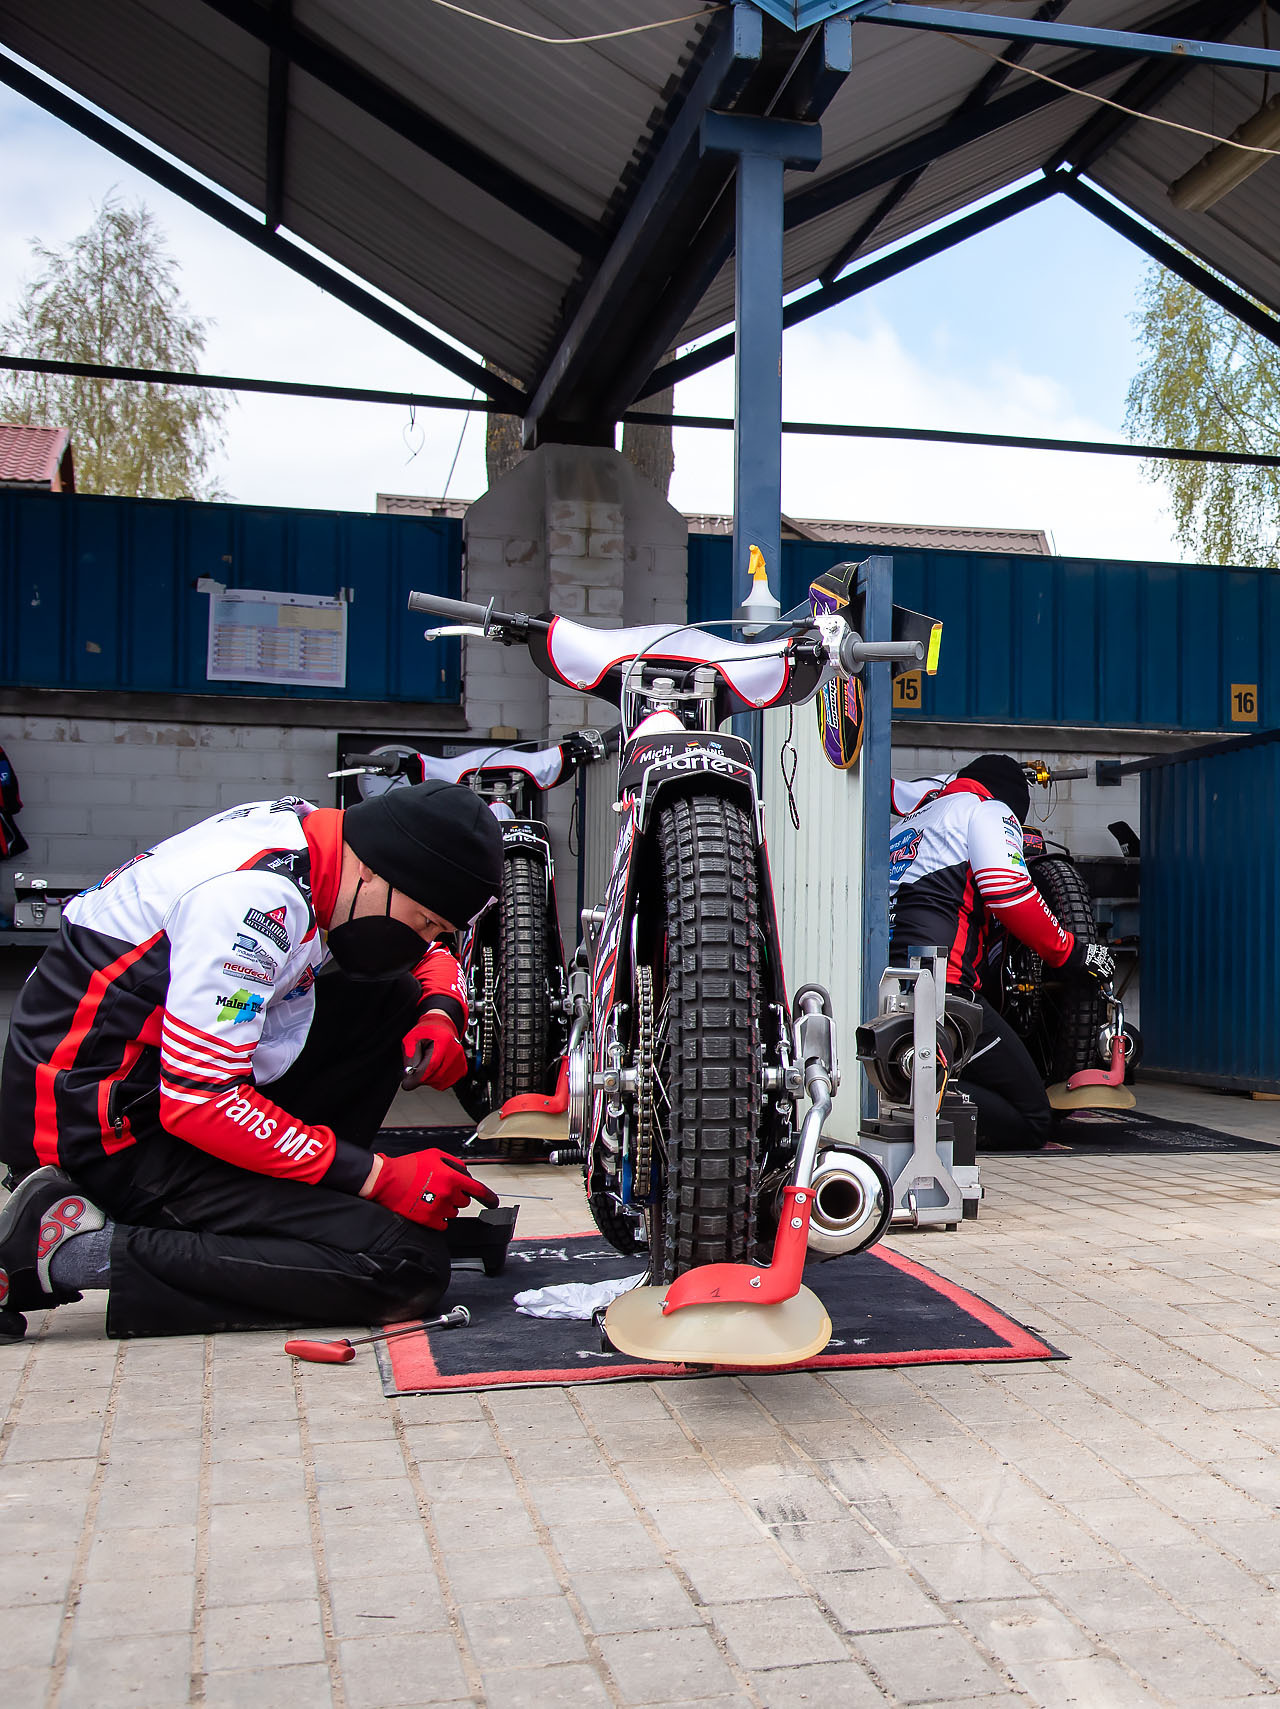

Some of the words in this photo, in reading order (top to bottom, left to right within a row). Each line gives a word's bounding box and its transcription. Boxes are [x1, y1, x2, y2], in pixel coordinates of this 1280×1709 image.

[895, 678, 918, 700] 15
[1233, 692, 1255, 714] 16
[640, 744, 674, 764] Michi
[216, 995, 250, 1011] Maler
[273, 1126, 324, 1161] MF
